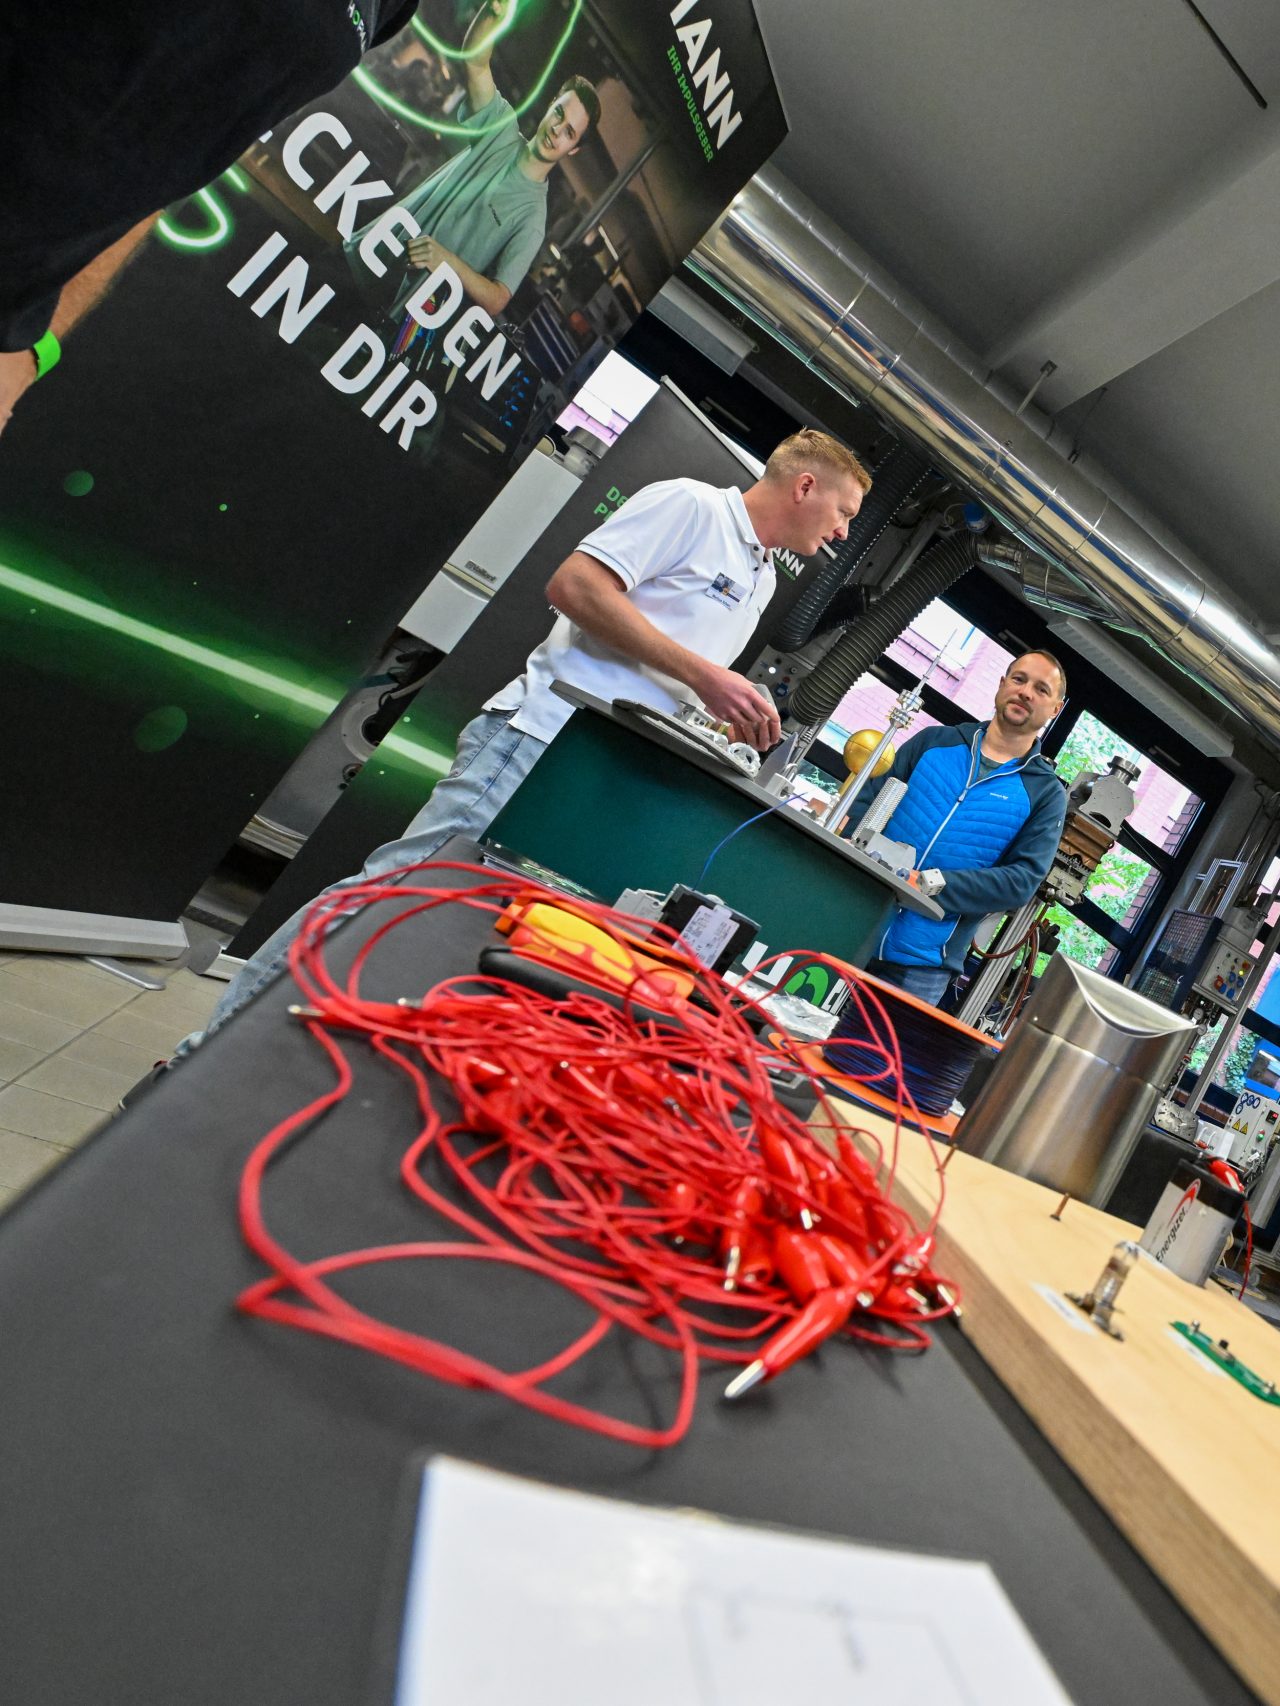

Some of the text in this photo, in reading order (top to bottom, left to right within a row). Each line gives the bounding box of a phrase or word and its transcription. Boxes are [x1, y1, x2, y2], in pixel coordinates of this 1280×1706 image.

[666, 45, 714, 163] IHR IMPULSGEBER
[226, 230, 438, 451] IN DIR
[258, 111, 522, 401] CKE DEN
[1155, 1206, 1187, 1263] Energizer
